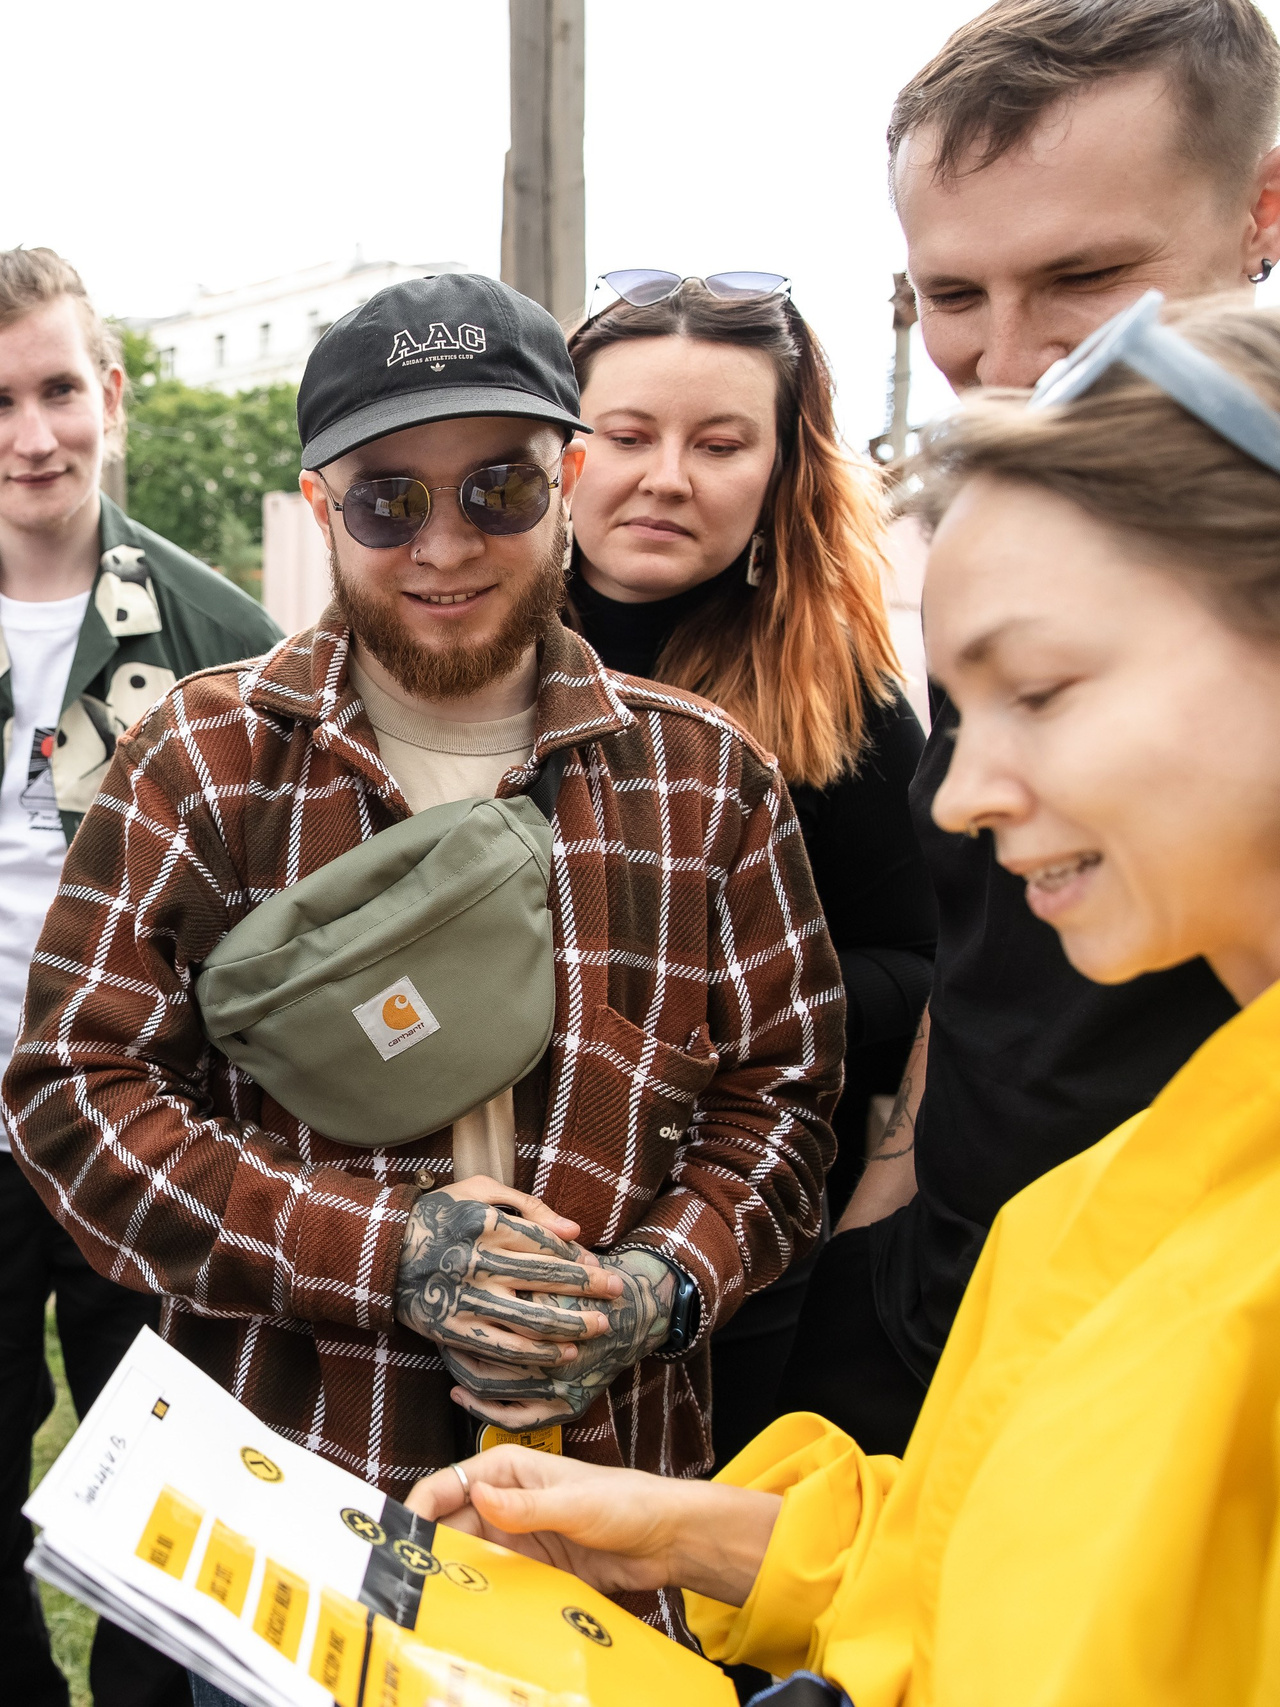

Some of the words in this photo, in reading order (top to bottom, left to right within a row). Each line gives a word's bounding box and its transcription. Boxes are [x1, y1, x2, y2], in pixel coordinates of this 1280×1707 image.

[387, 323, 486, 367] AAC
[402, 358, 423, 366] ADIDAS
[424, 354, 457, 362] ATHLETICS
[387, 1022, 425, 1047] carhartt
